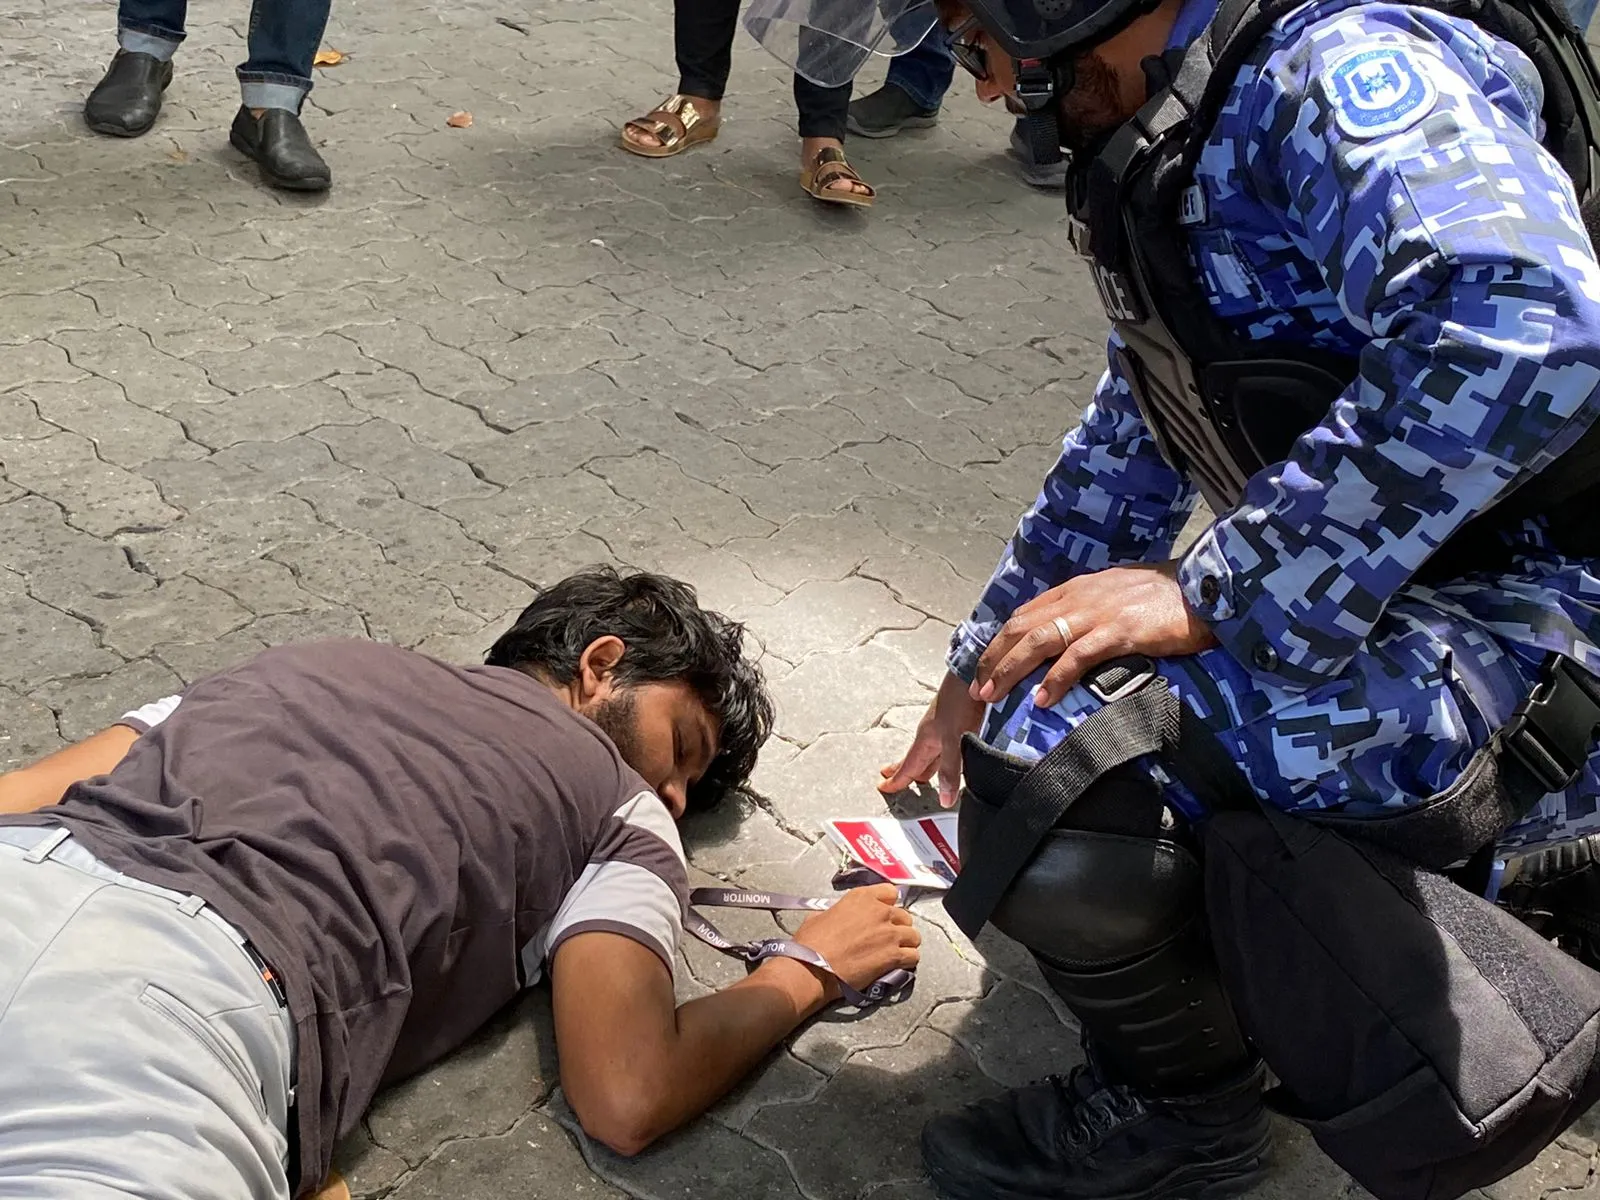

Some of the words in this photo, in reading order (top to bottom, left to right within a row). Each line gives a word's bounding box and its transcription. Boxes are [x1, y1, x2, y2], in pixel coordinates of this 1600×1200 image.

[1093, 264, 1136, 320] ICE
[859, 833, 896, 866] PRESS
[723, 893, 771, 904] MONITOR
[697, 923, 732, 949] MONIT
